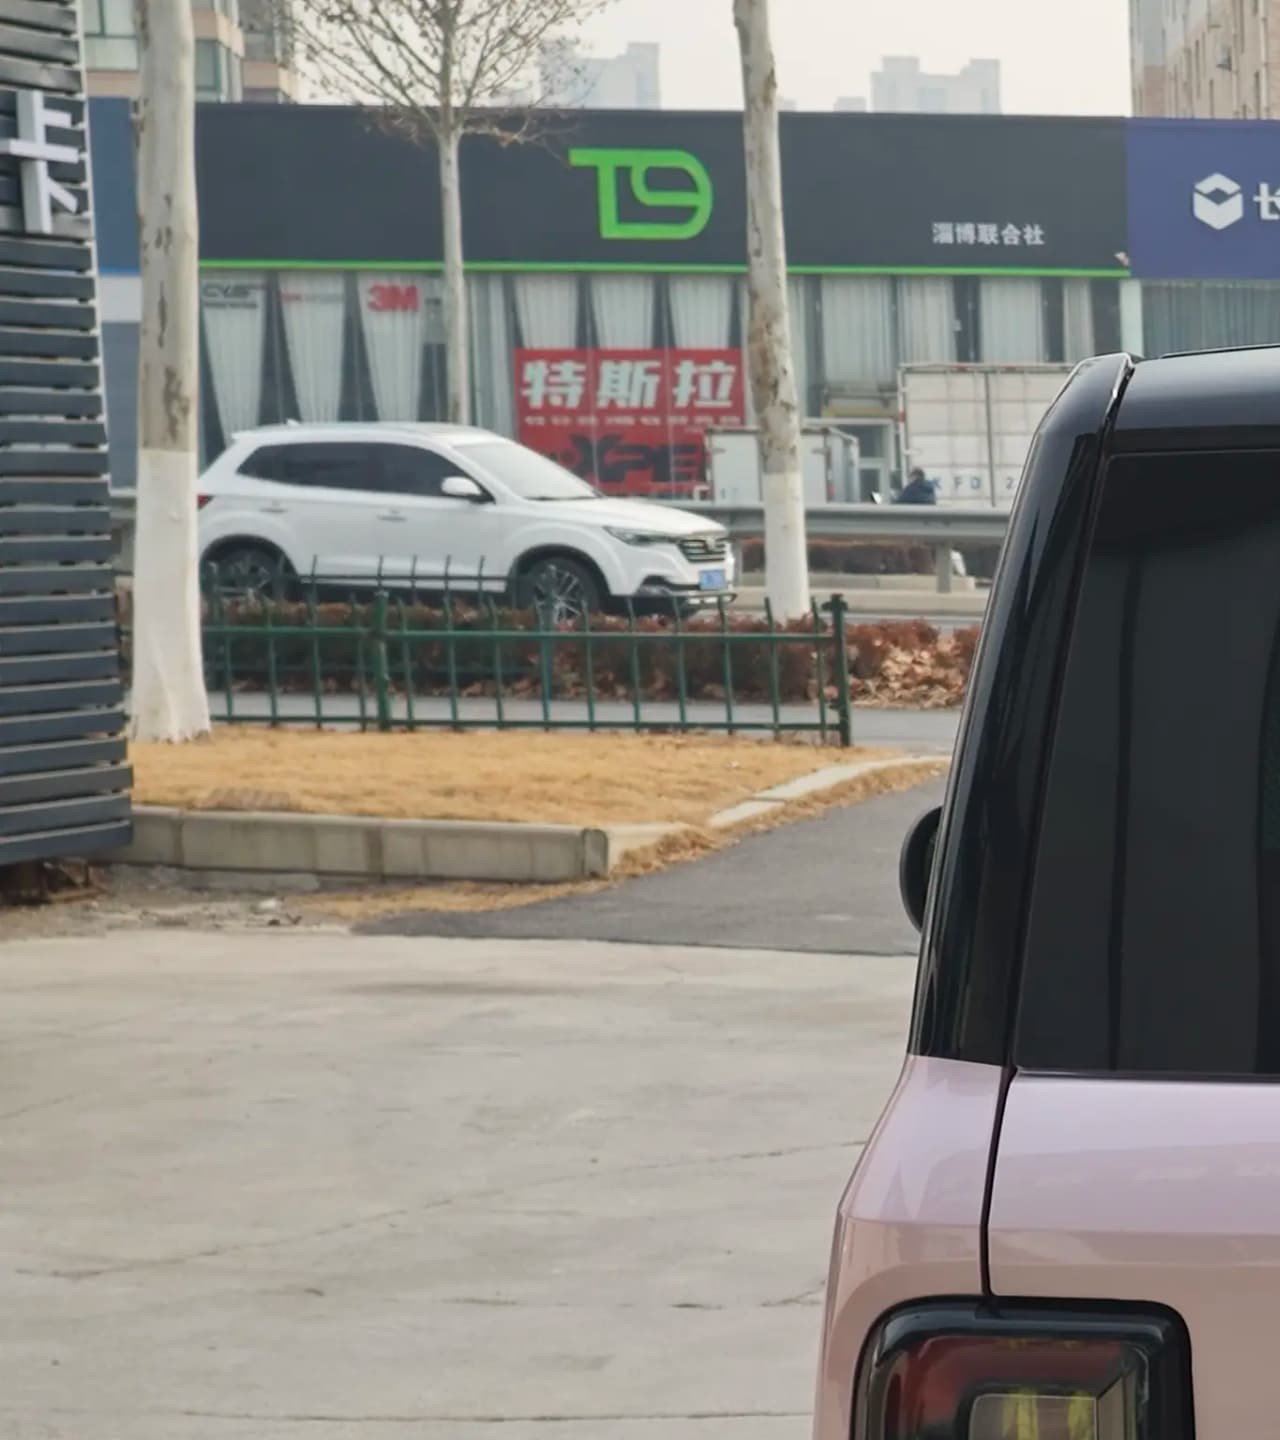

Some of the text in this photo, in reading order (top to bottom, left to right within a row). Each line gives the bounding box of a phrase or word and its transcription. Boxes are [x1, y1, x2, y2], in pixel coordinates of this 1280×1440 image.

[368, 285, 419, 312] 3M
[522, 360, 736, 408] 特斯拉
